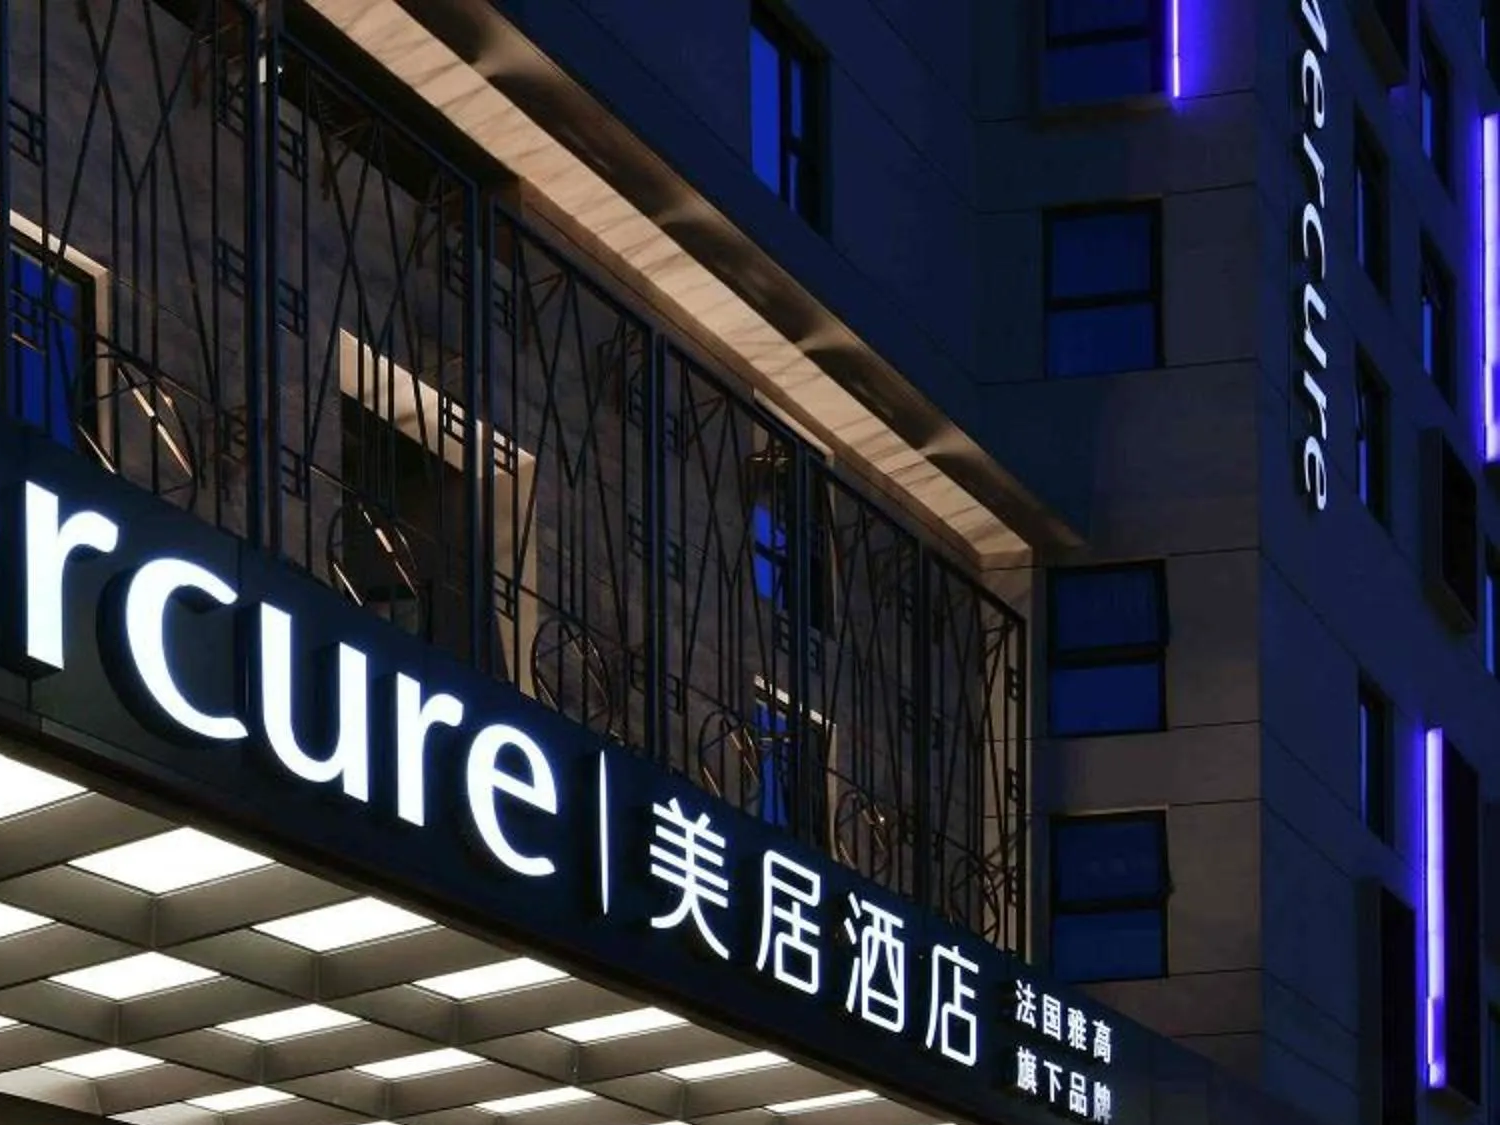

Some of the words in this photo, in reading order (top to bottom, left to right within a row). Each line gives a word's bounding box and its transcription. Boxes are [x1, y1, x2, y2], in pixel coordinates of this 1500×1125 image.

[649, 798, 979, 1067] 美居酒店
[1015, 979, 1112, 1064] 法国雅高
[1017, 1045, 1113, 1125] 旗下品牌
